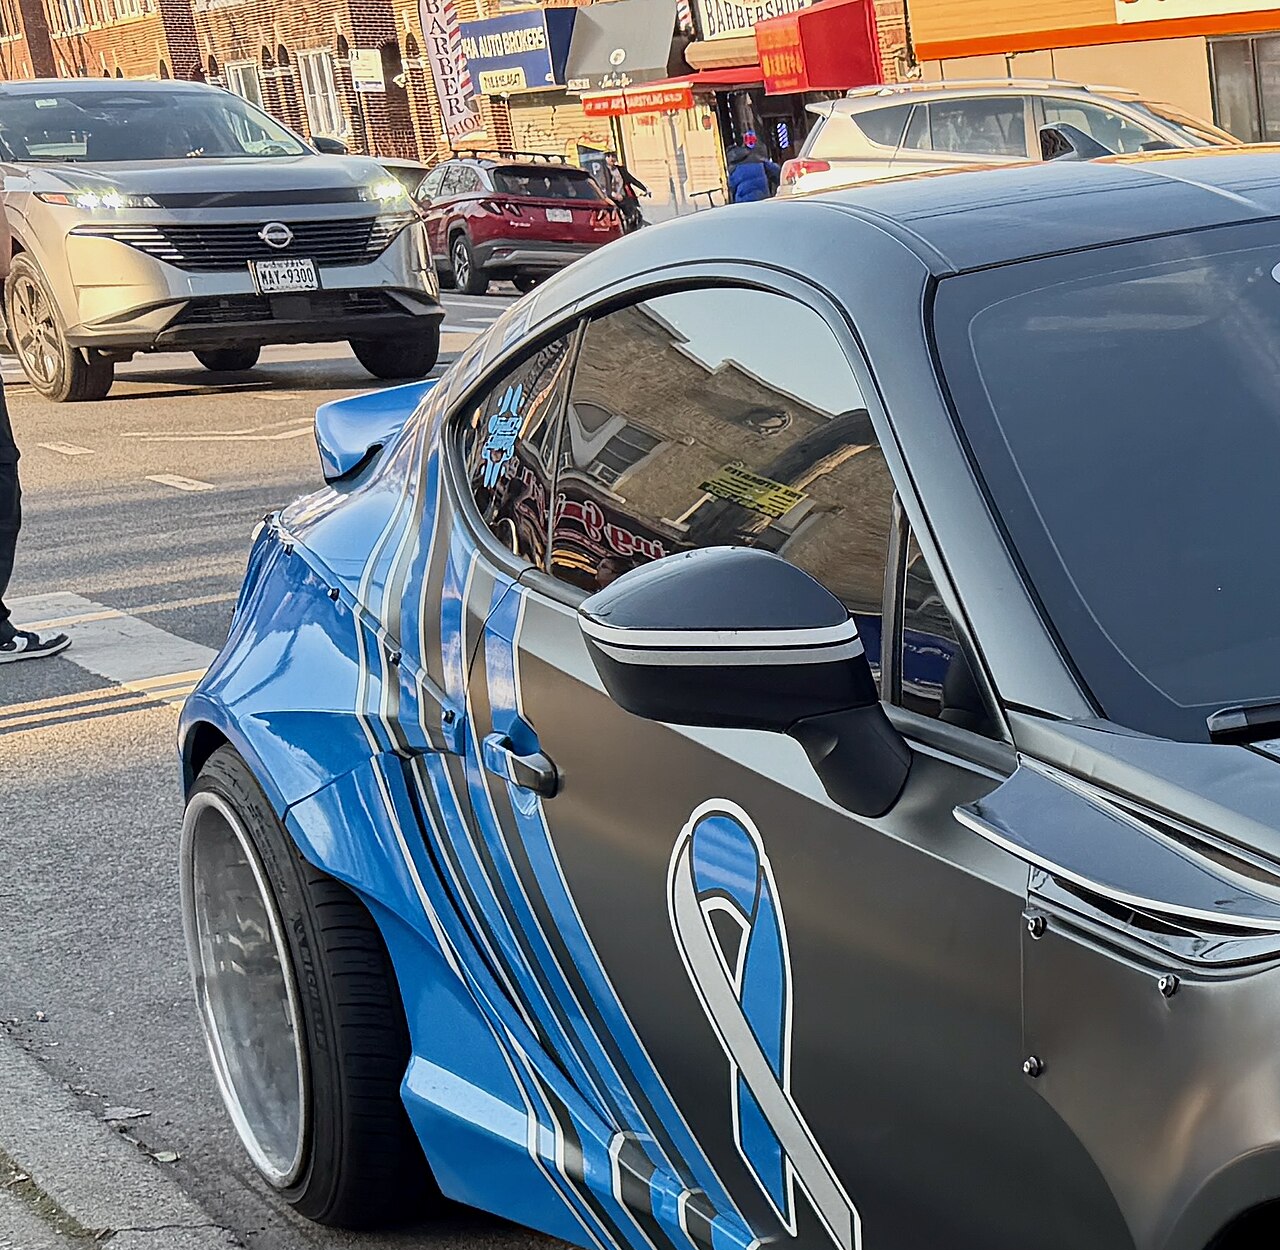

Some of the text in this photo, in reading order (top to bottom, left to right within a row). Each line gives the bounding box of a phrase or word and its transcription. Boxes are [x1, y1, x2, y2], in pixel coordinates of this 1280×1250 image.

[704, 0, 804, 36] BARBERSHO
[426, 0, 464, 116] BARBER
[479, 34, 504, 58] AUTO
[504, 26, 546, 56] BROKERS
[448, 114, 481, 139] SHOP
